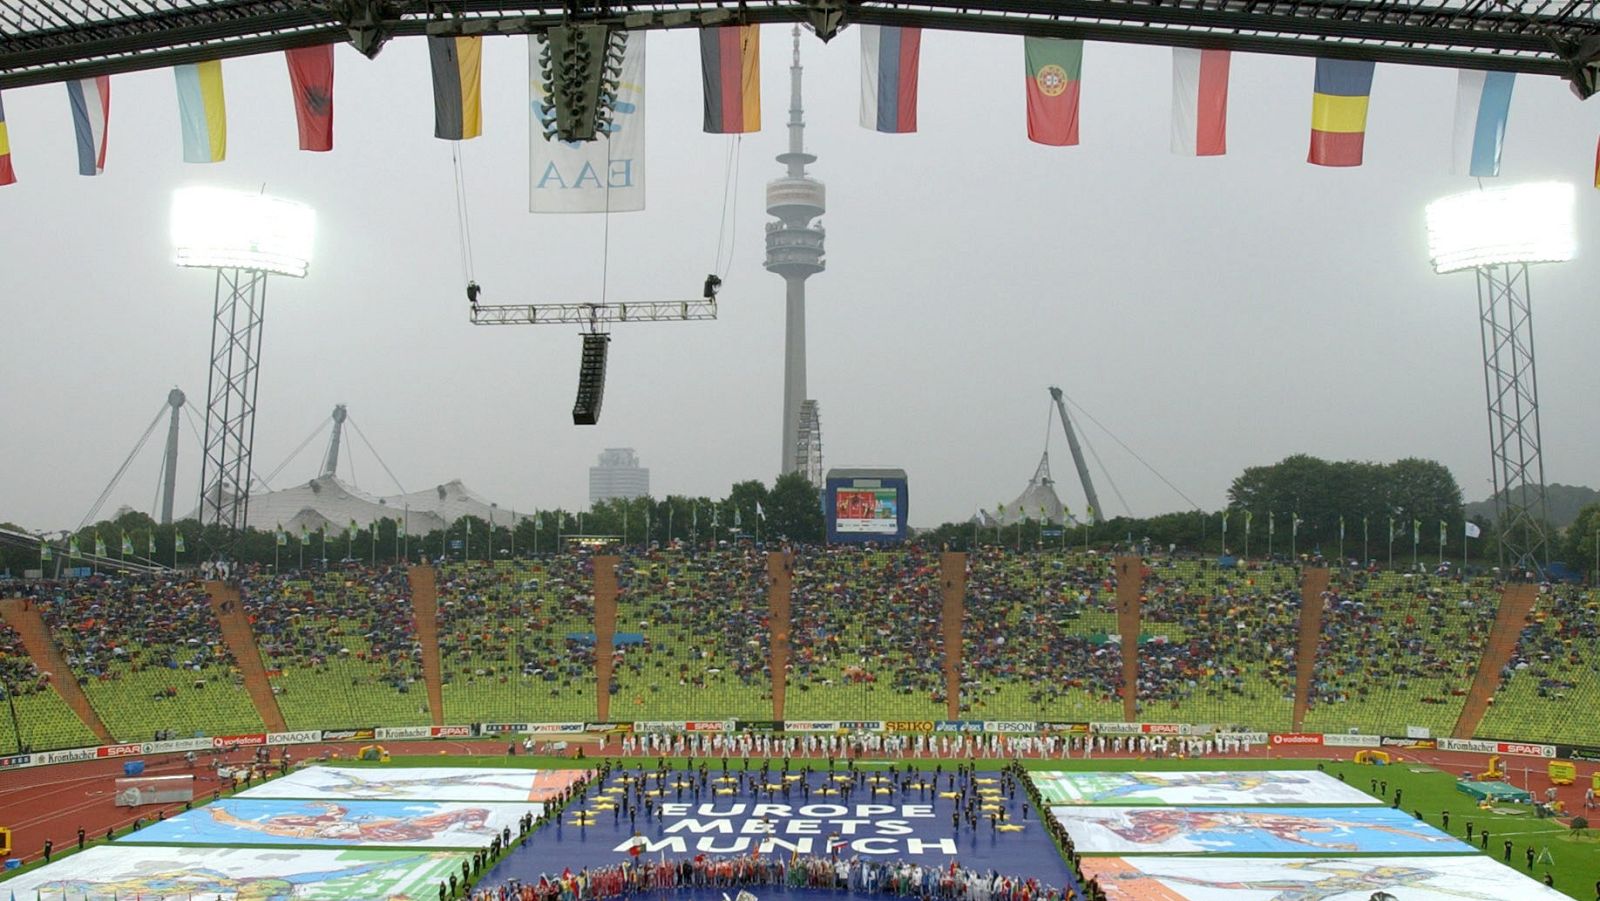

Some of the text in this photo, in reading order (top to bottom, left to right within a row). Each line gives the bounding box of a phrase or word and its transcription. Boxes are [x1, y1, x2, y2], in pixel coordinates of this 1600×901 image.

[440, 727, 469, 736] SPAR
[694, 722, 723, 730] SPAR
[886, 721, 934, 732] SEIKO
[998, 722, 1033, 732] EPSON
[1150, 725, 1179, 734] SPAR
[224, 736, 263, 746] vodafone
[268, 732, 310, 743] BONAQA
[107, 744, 141, 756] SPAR
[1447, 739, 1495, 752] Krombacher
[1508, 744, 1541, 755] SPAR
[48, 750, 96, 764] Krombacher
[653, 803, 936, 818] EUROPE
[663, 818, 914, 835] MEETS
[612, 835, 958, 855] MUNICH
